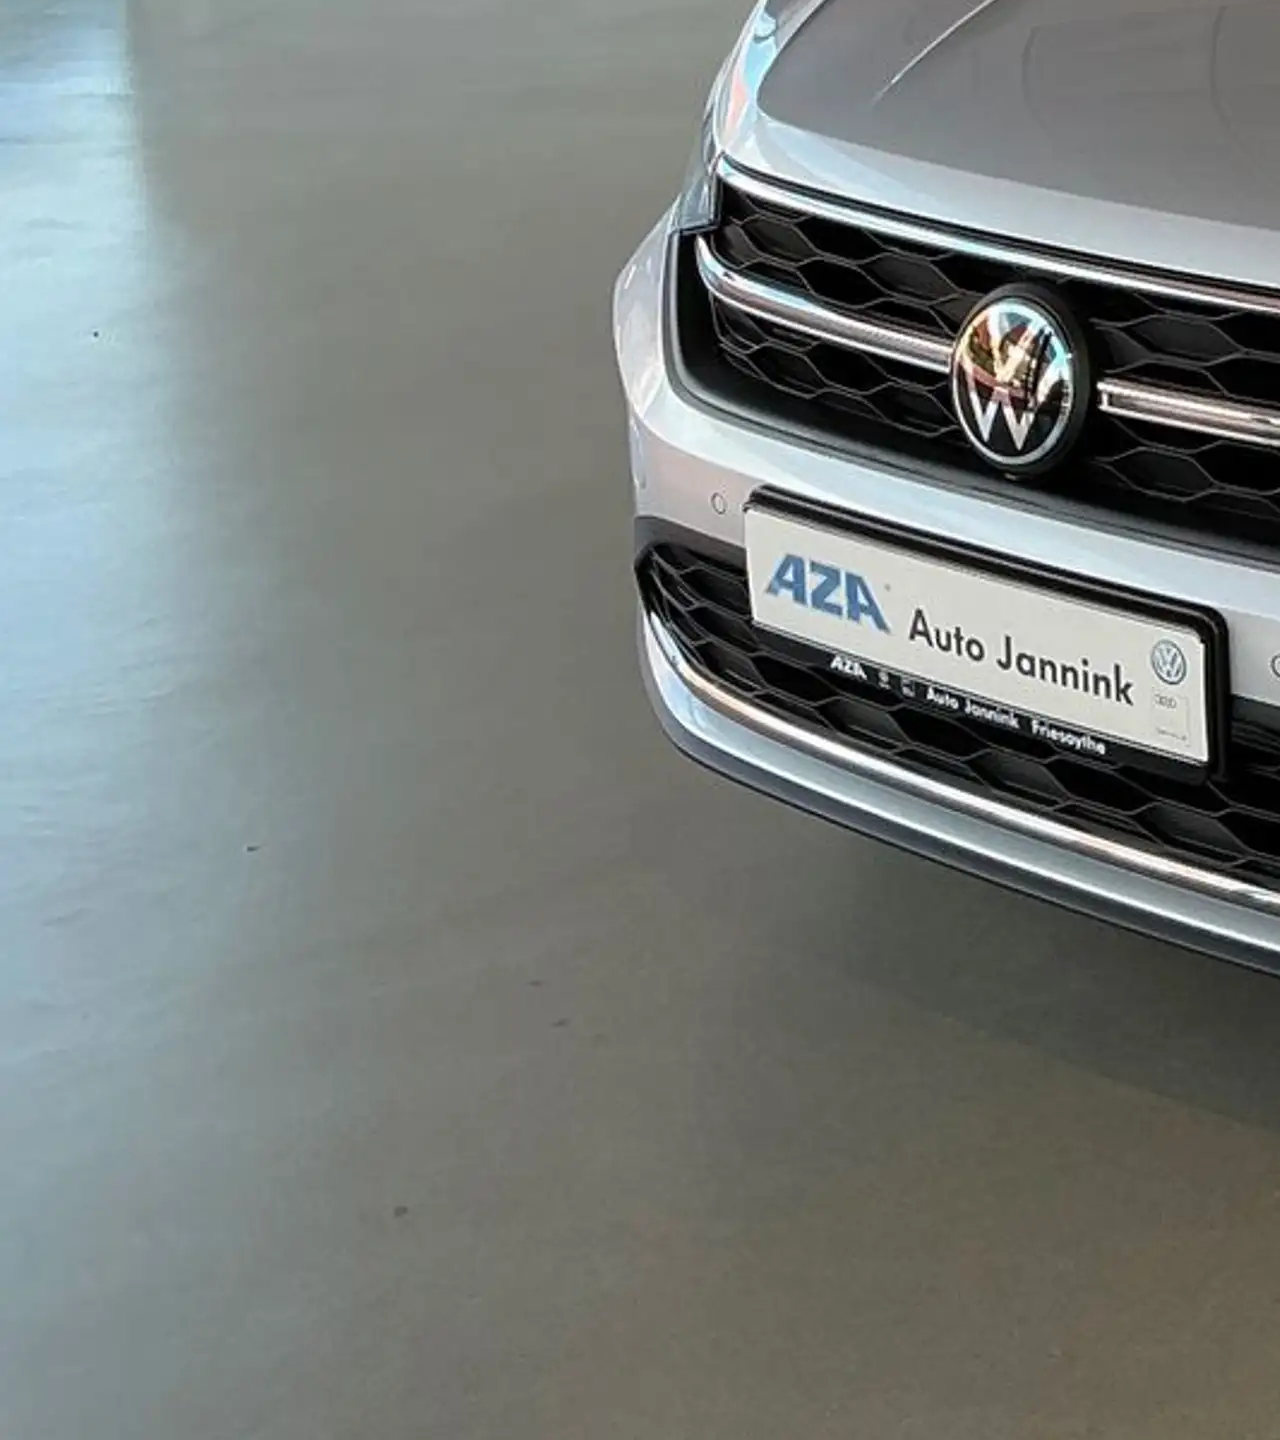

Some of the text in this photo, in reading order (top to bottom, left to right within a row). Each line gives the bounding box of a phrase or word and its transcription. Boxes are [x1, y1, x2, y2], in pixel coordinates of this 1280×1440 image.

[766, 554, 891, 634] AZA
[909, 607, 1134, 707] Auto Jannink
[926, 686, 960, 710] Auto
[964, 699, 1020, 730] Jannink
